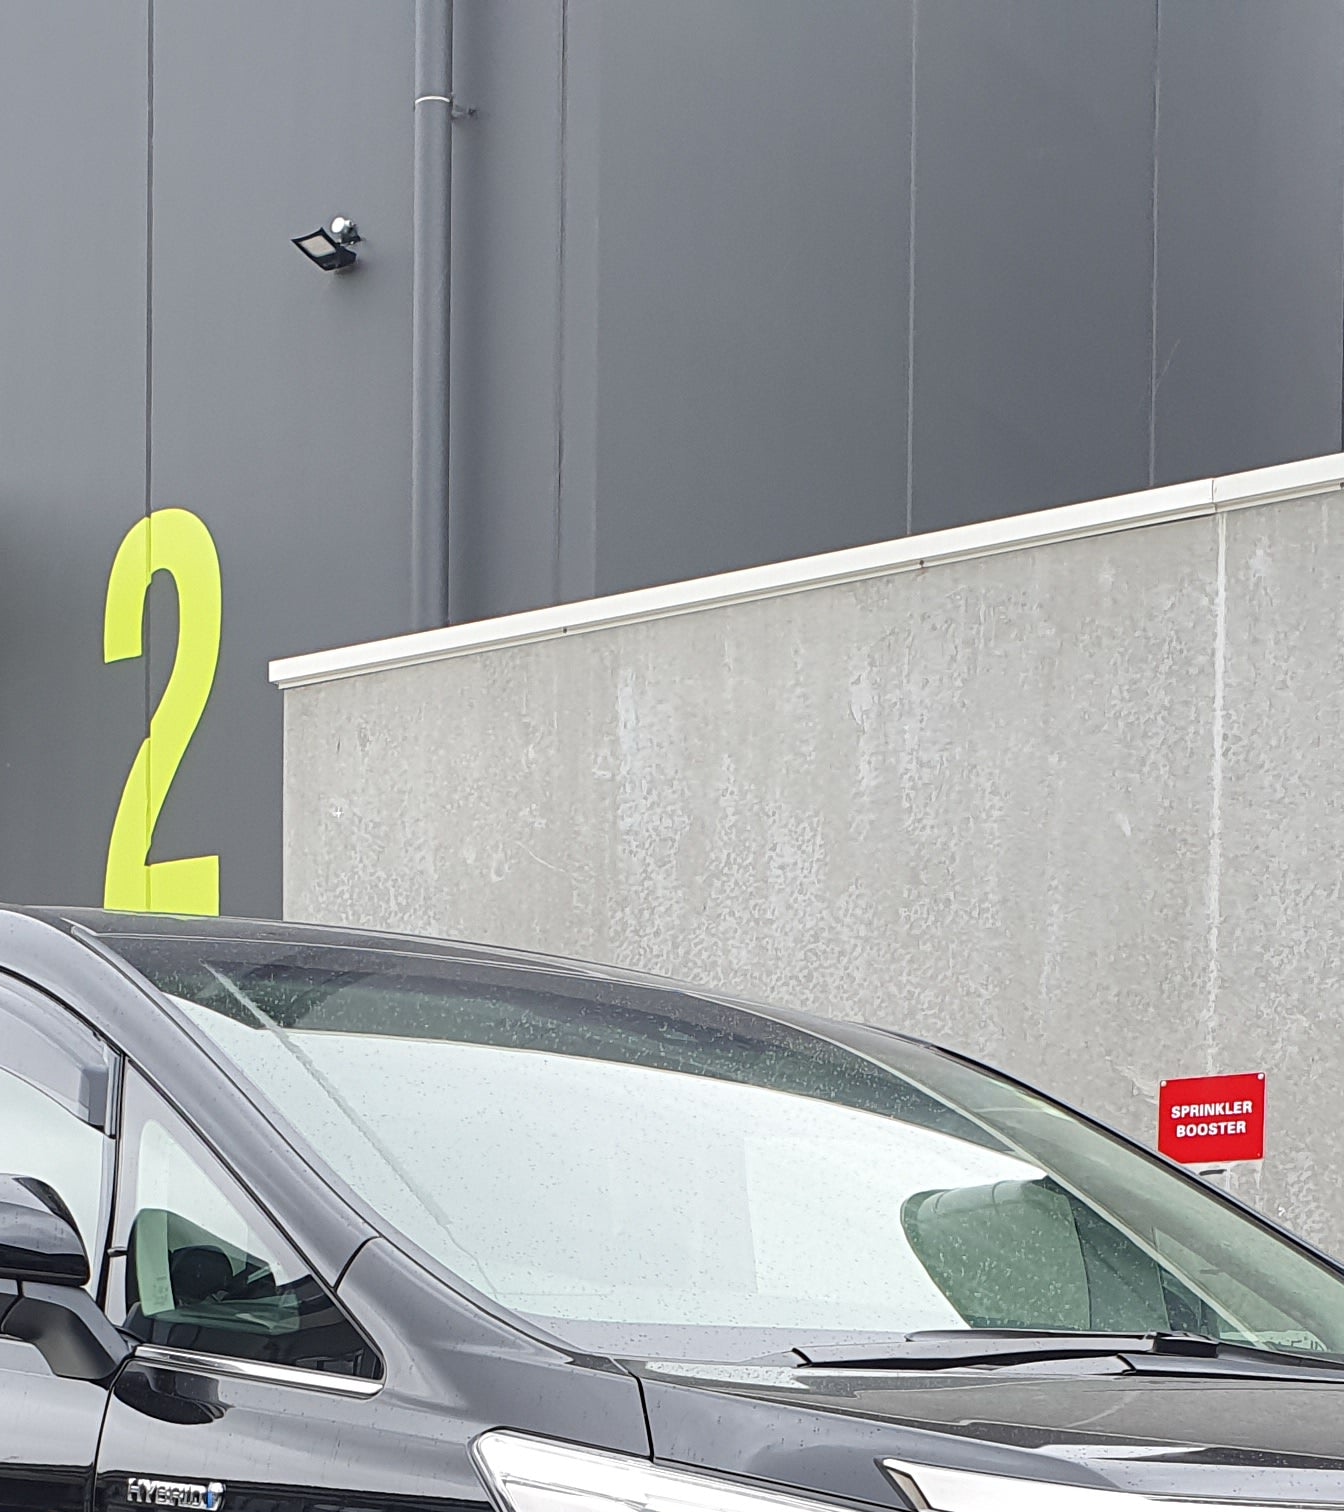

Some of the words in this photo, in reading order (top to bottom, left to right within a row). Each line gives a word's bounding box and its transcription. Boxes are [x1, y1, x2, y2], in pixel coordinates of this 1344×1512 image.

[103, 508, 222, 917] 2
[1171, 1101, 1253, 1119] SPRINKLER
[1176, 1121, 1247, 1138] BOOSTER
